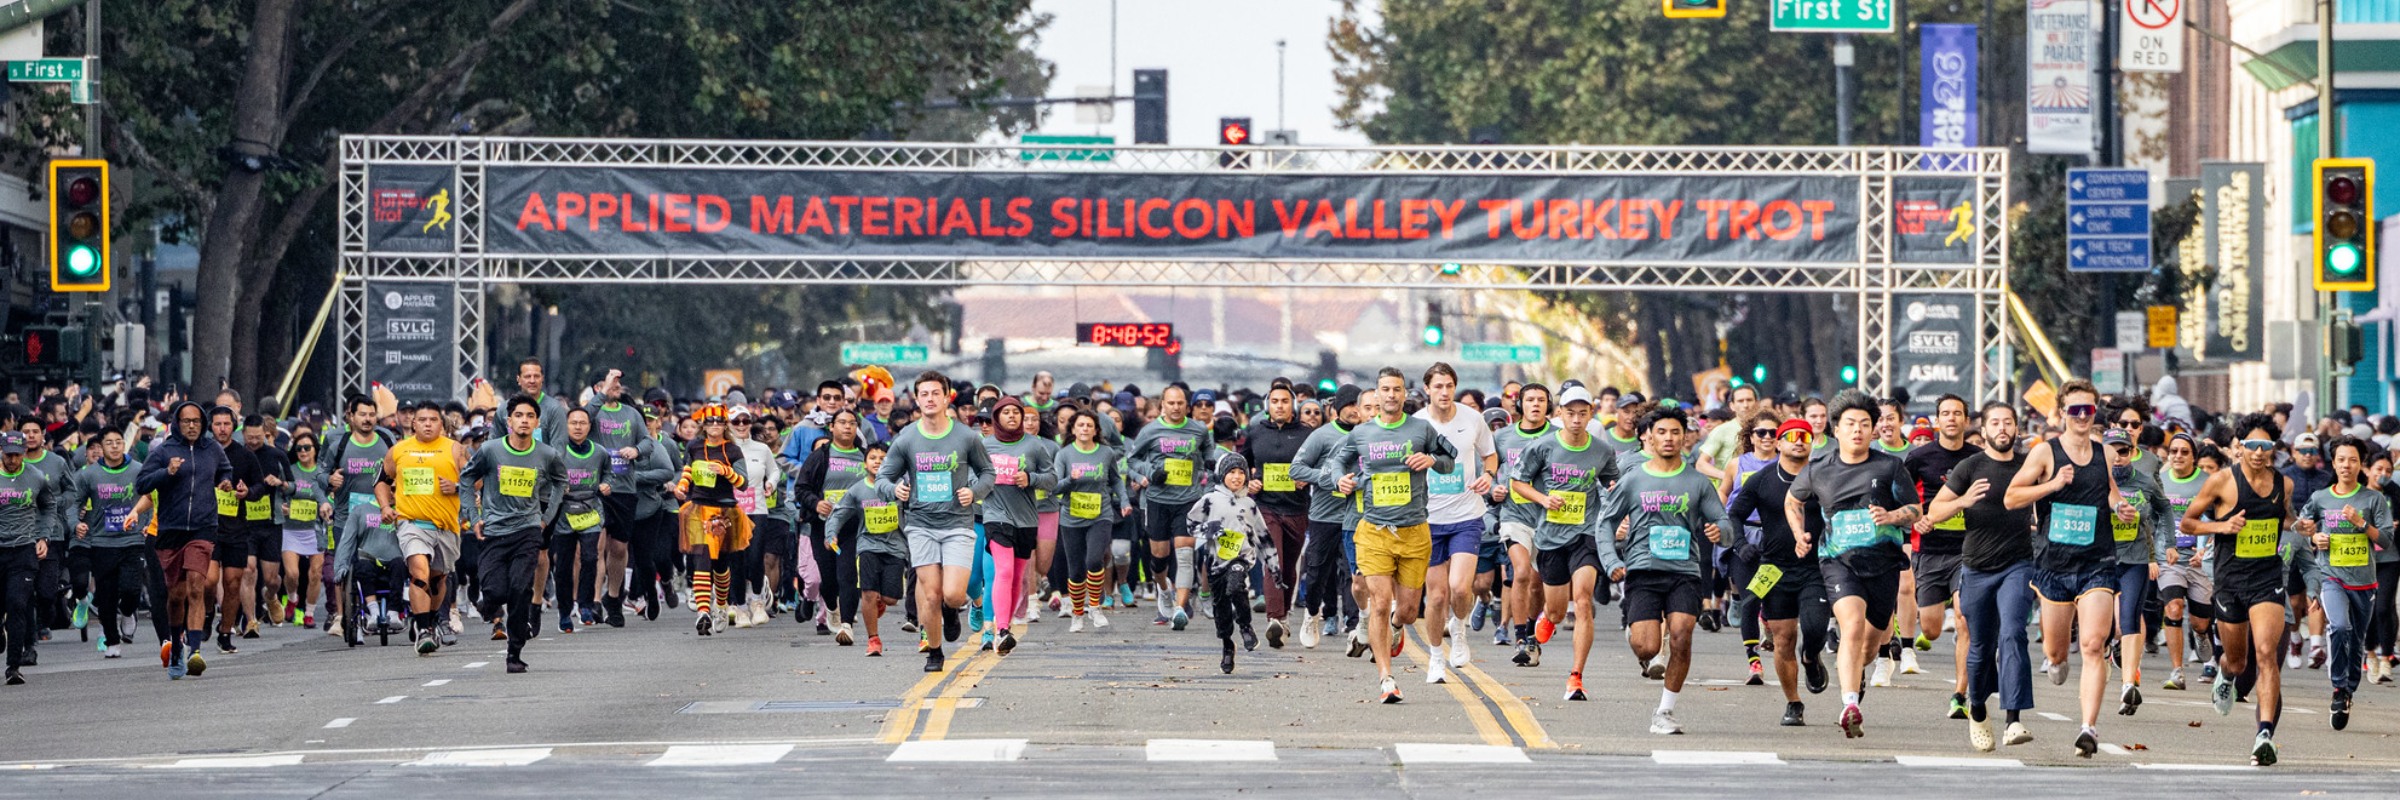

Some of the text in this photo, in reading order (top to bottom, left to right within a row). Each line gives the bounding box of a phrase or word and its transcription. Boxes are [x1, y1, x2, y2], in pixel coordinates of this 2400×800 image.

[1777, 0, 1886, 20] First St
[2139, 36, 2163, 49] ON
[2133, 52, 2168, 65] RED
[25, 62, 63, 77] First
[71, 69, 80, 77] St
[2086, 173, 2147, 184] CONVENTION
[2086, 187, 2125, 198] CENTER
[373, 191, 429, 211] Turkey
[516, 191, 1835, 241] APPLIED MATERIALS SILICON VALLEY TURKEY TROT
[2086, 207, 2132, 218] SAN JOSE
[2086, 221, 2112, 232] CIVIC
[2087, 241, 2133, 252] THE TECH
[2088, 255, 2146, 266] INTERACTIVE
[391, 322, 430, 333] SVLG
[1912, 334, 1955, 346] SVLG
[1909, 365, 1959, 381] ASML
[1369, 443, 1401, 453] Turkey
[916, 454, 947, 464] Turkey
[1369, 451, 1386, 460] Trot
[348, 458, 375, 468] Turkey
[916, 462, 932, 471] Trot
[1551, 466, 1585, 477] Turkey
[410, 478, 434, 486] 12045
[508, 478, 533, 488] 11576
[1440, 474, 1462, 483] 5804
[1552, 474, 1569, 483] Trot
[927, 483, 949, 492] 5806
[1381, 484, 1410, 494] 11332
[0, 490, 23, 500] urkey
[1639, 493, 1677, 505] Turkey
[1077, 502, 1100, 511] 14507
[1641, 502, 1660, 513] Trot
[873, 516, 898, 525] 12546
[2063, 520, 2092, 532] 3328
[1845, 523, 1871, 535] 3525
[1662, 539, 1686, 549] 3544
[2248, 533, 2276, 545] 13619
[2339, 546, 2367, 556] 14379
